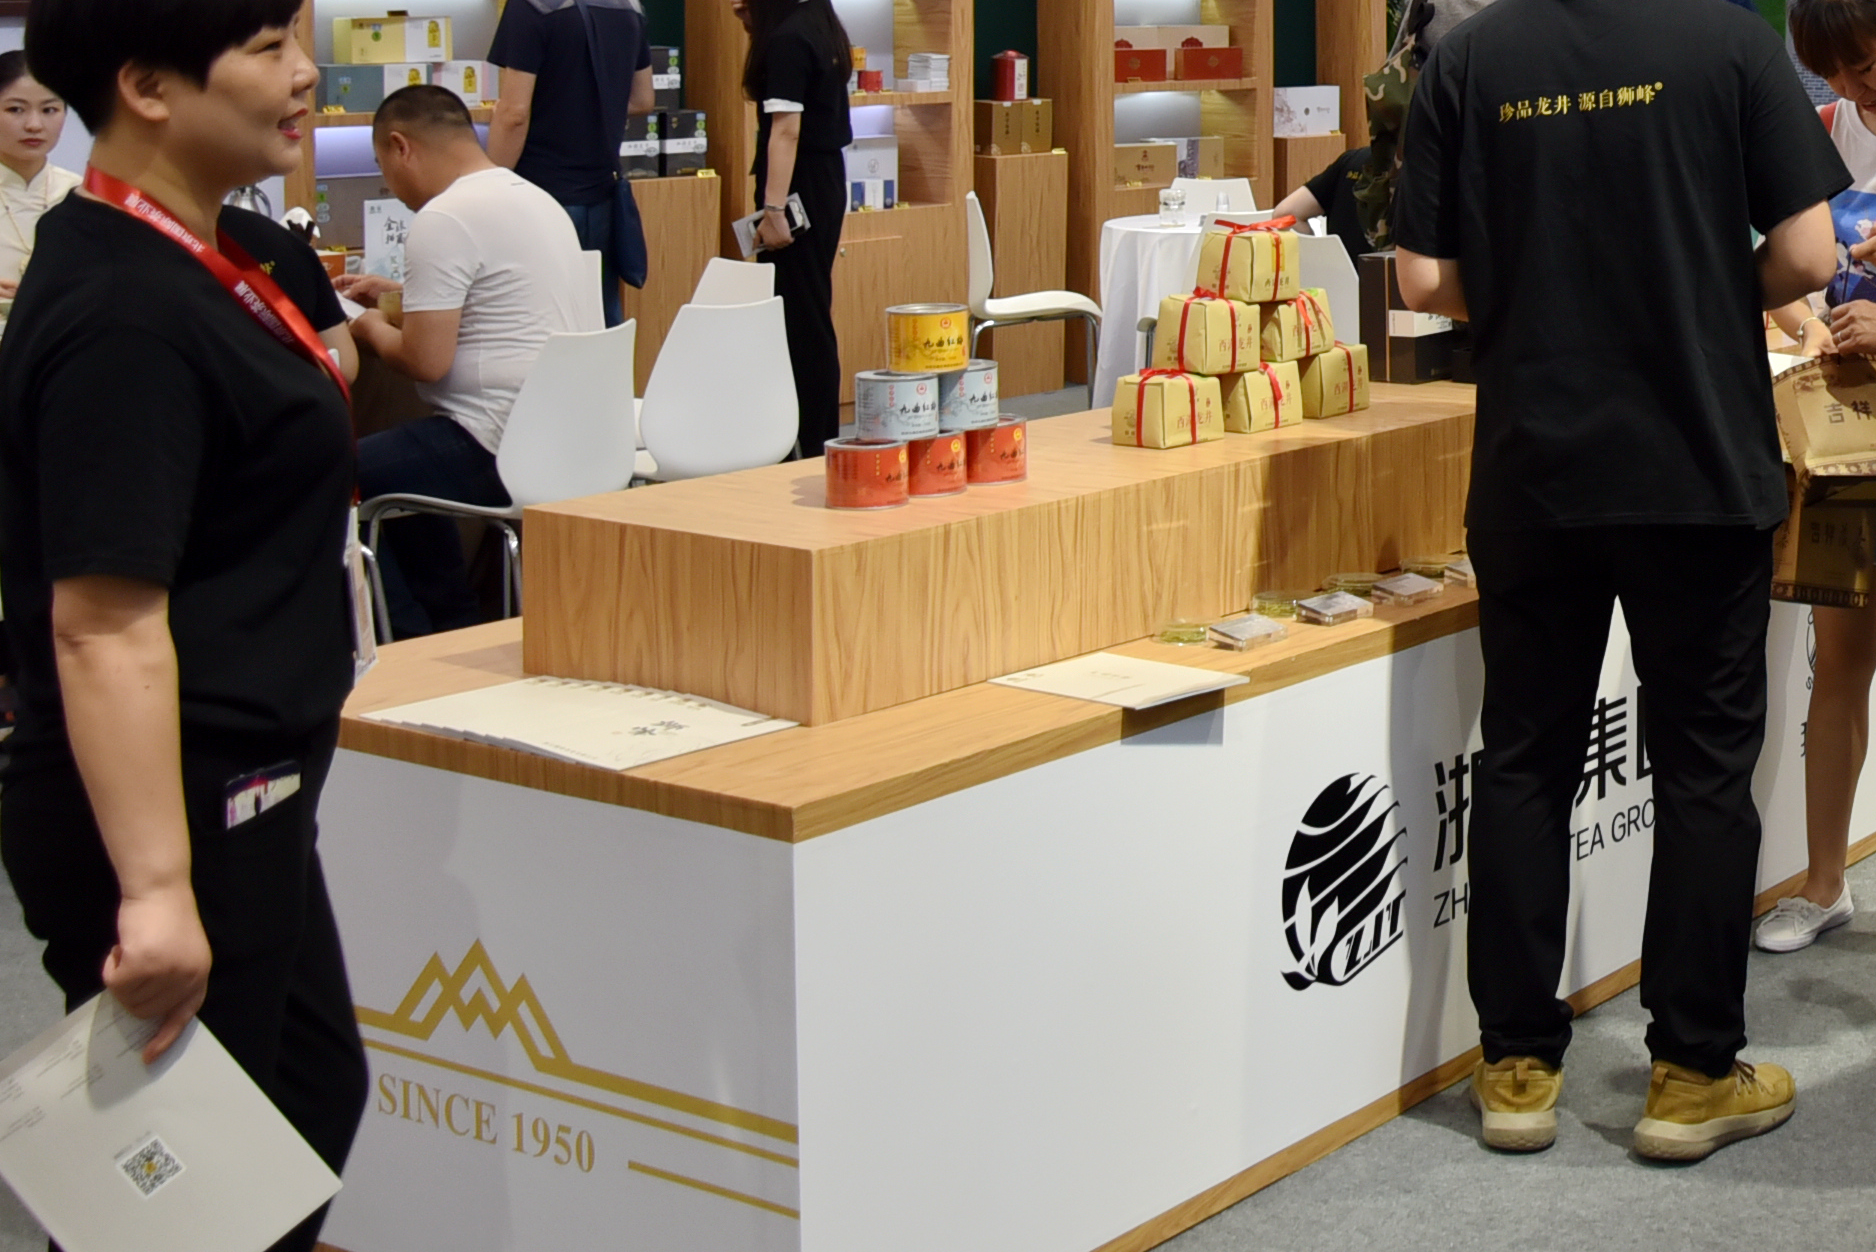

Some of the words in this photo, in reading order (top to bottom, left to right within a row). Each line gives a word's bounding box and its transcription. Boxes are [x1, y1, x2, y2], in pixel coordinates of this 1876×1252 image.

[1499, 95, 1571, 124] 珍品龙井
[1578, 84, 1656, 112] 源自狮峰
[377, 1072, 497, 1147] SINCE
[511, 1111, 597, 1175] 1950
